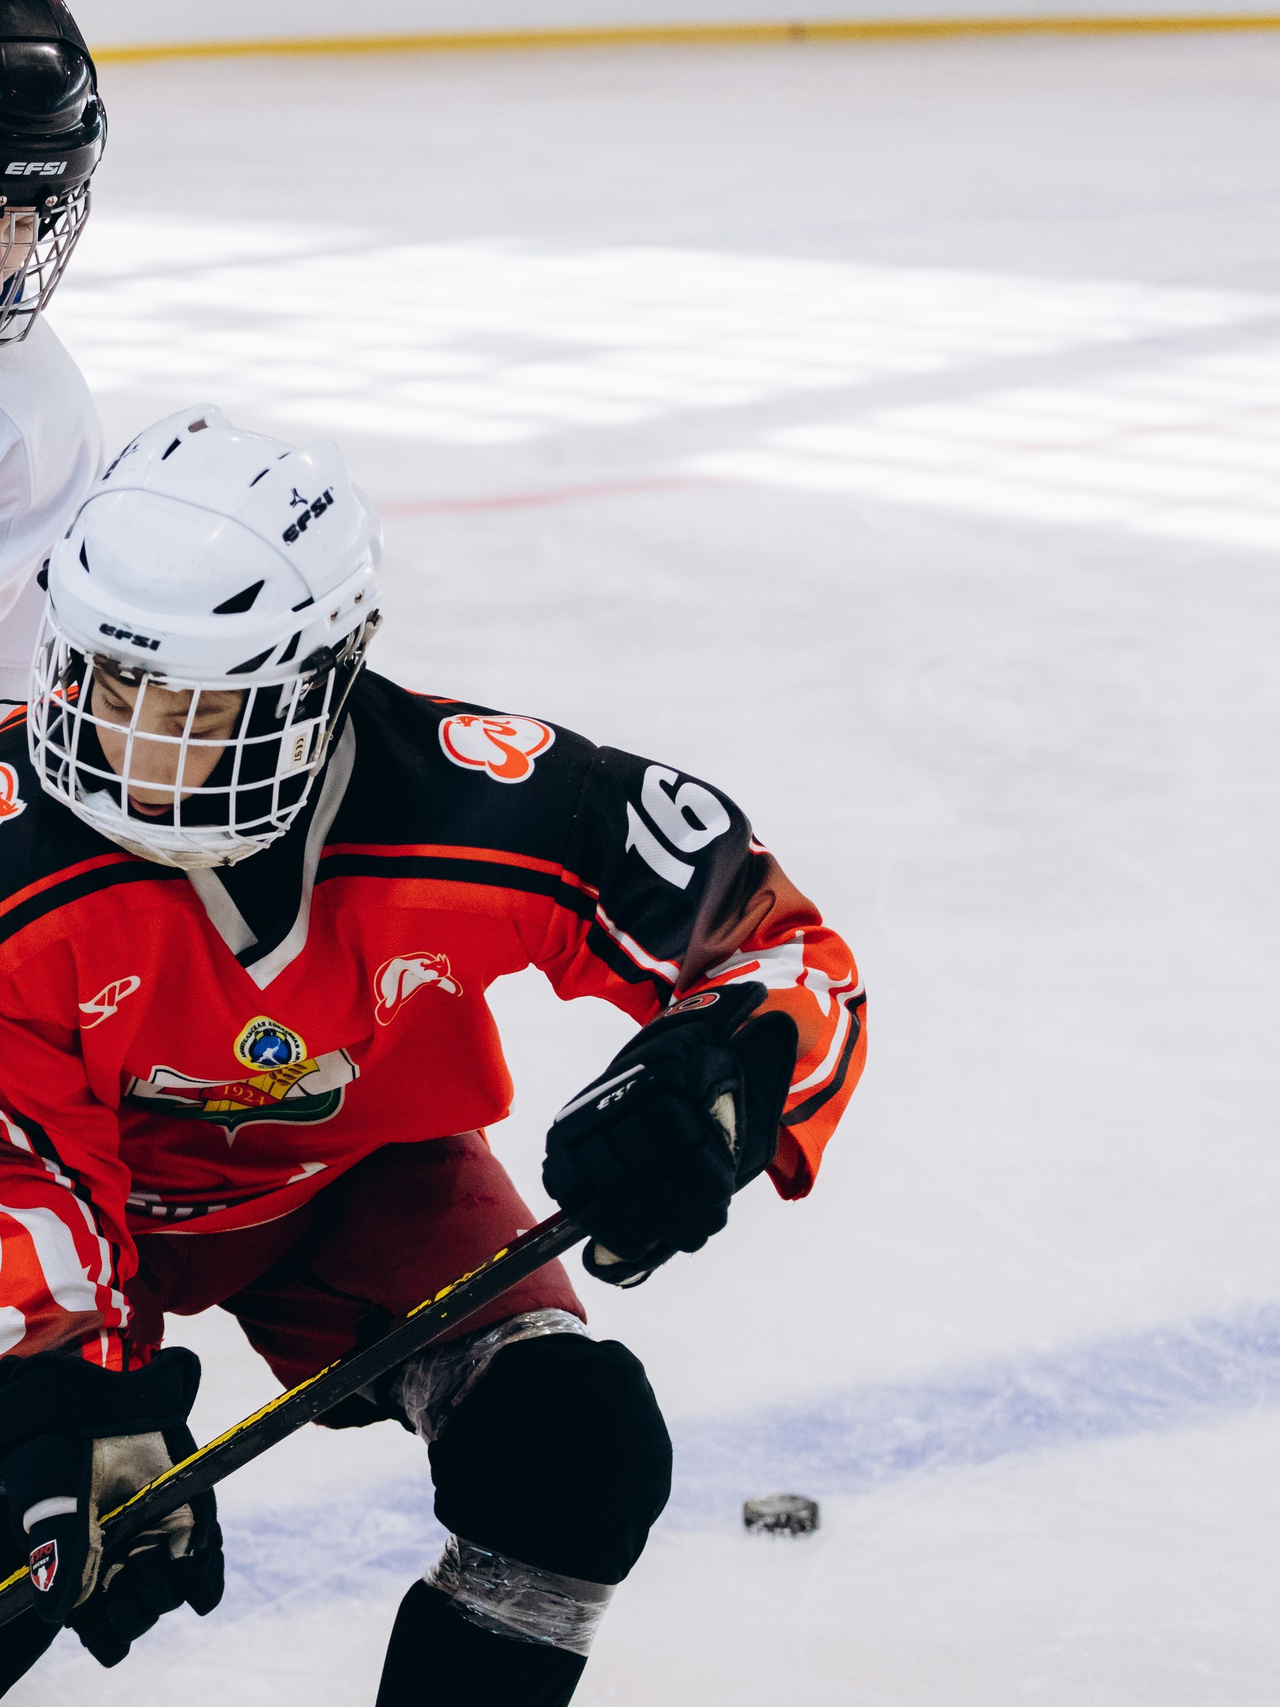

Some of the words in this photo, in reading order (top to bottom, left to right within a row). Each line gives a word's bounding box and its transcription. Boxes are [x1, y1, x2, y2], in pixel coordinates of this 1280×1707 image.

[4, 161, 67, 175] EFSI
[282, 488, 334, 545] EFSI
[99, 622, 161, 651] EFSI
[625, 764, 731, 890] 16
